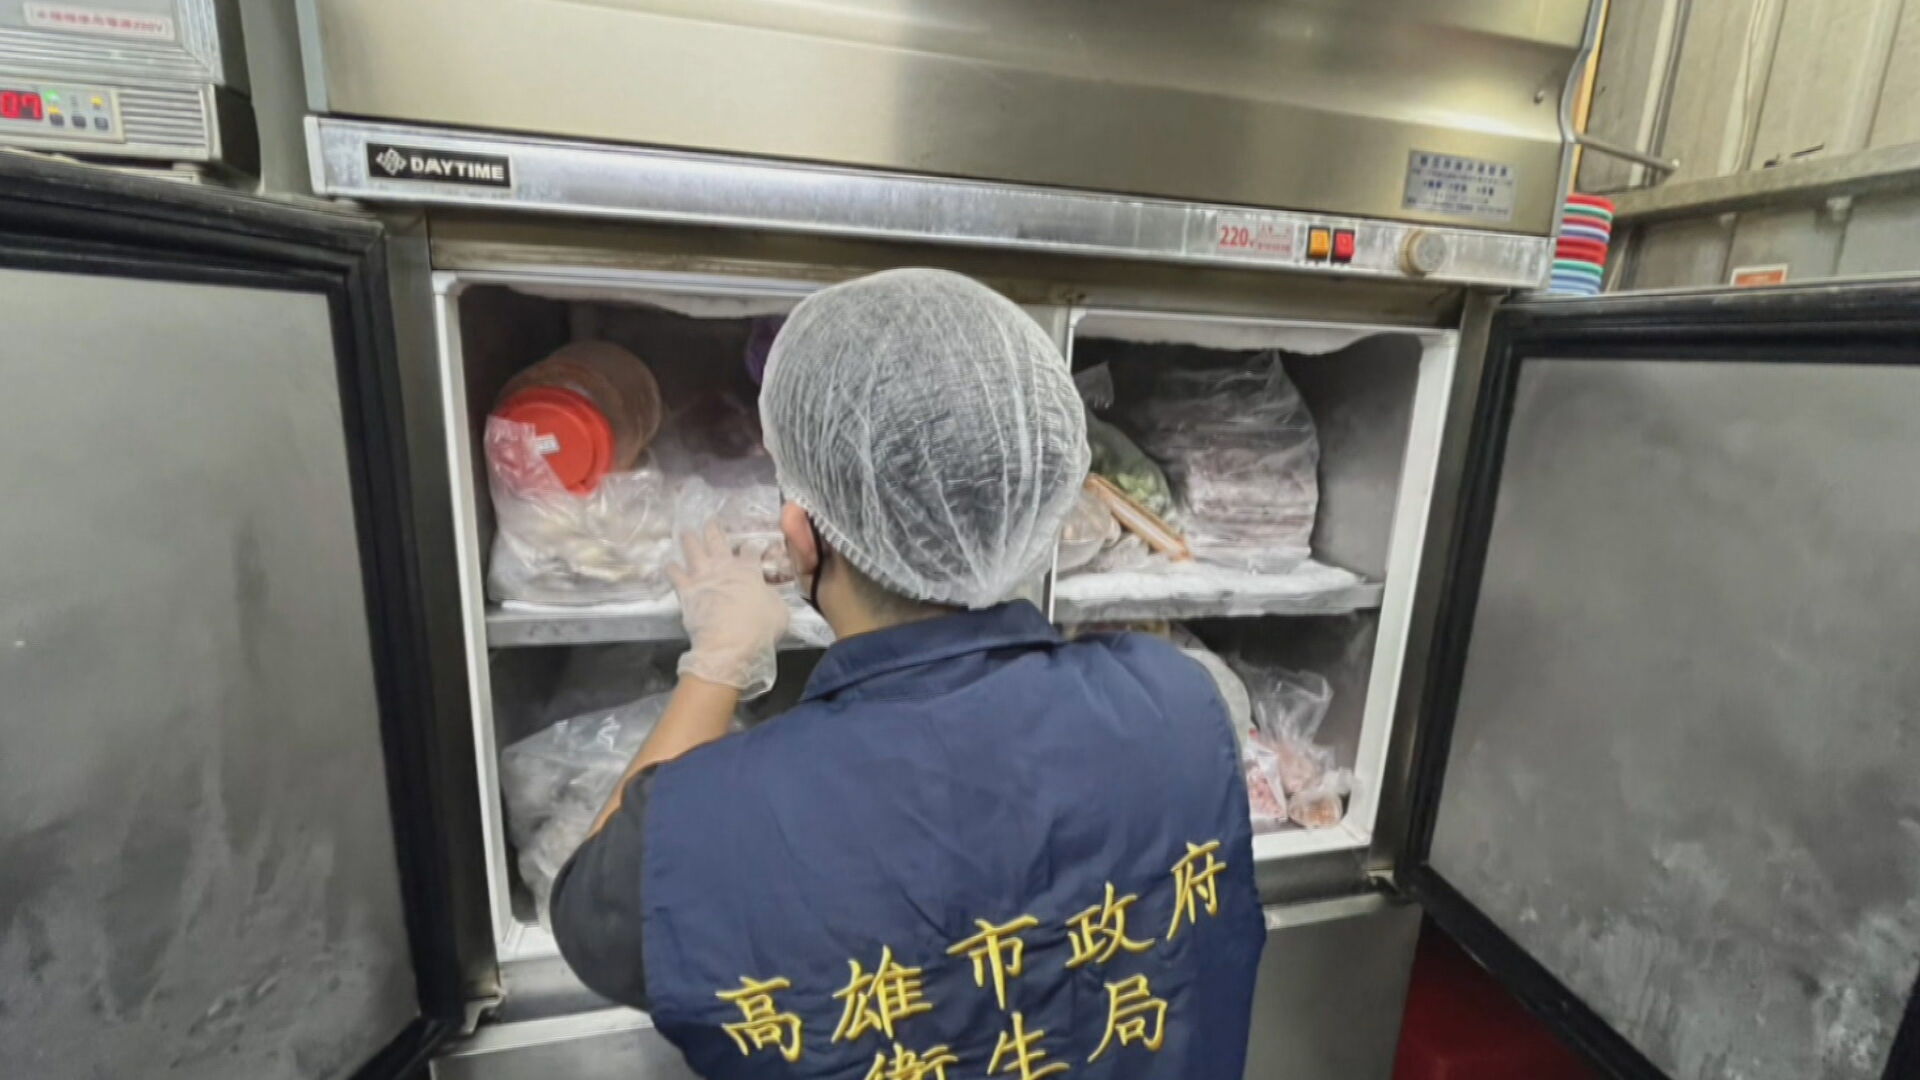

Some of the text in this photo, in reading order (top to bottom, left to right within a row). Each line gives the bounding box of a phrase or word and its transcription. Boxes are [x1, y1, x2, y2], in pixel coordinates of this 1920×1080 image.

[409, 156, 505, 182] DAYTIME
[716, 839, 1227, 1062] 高雄市政府
